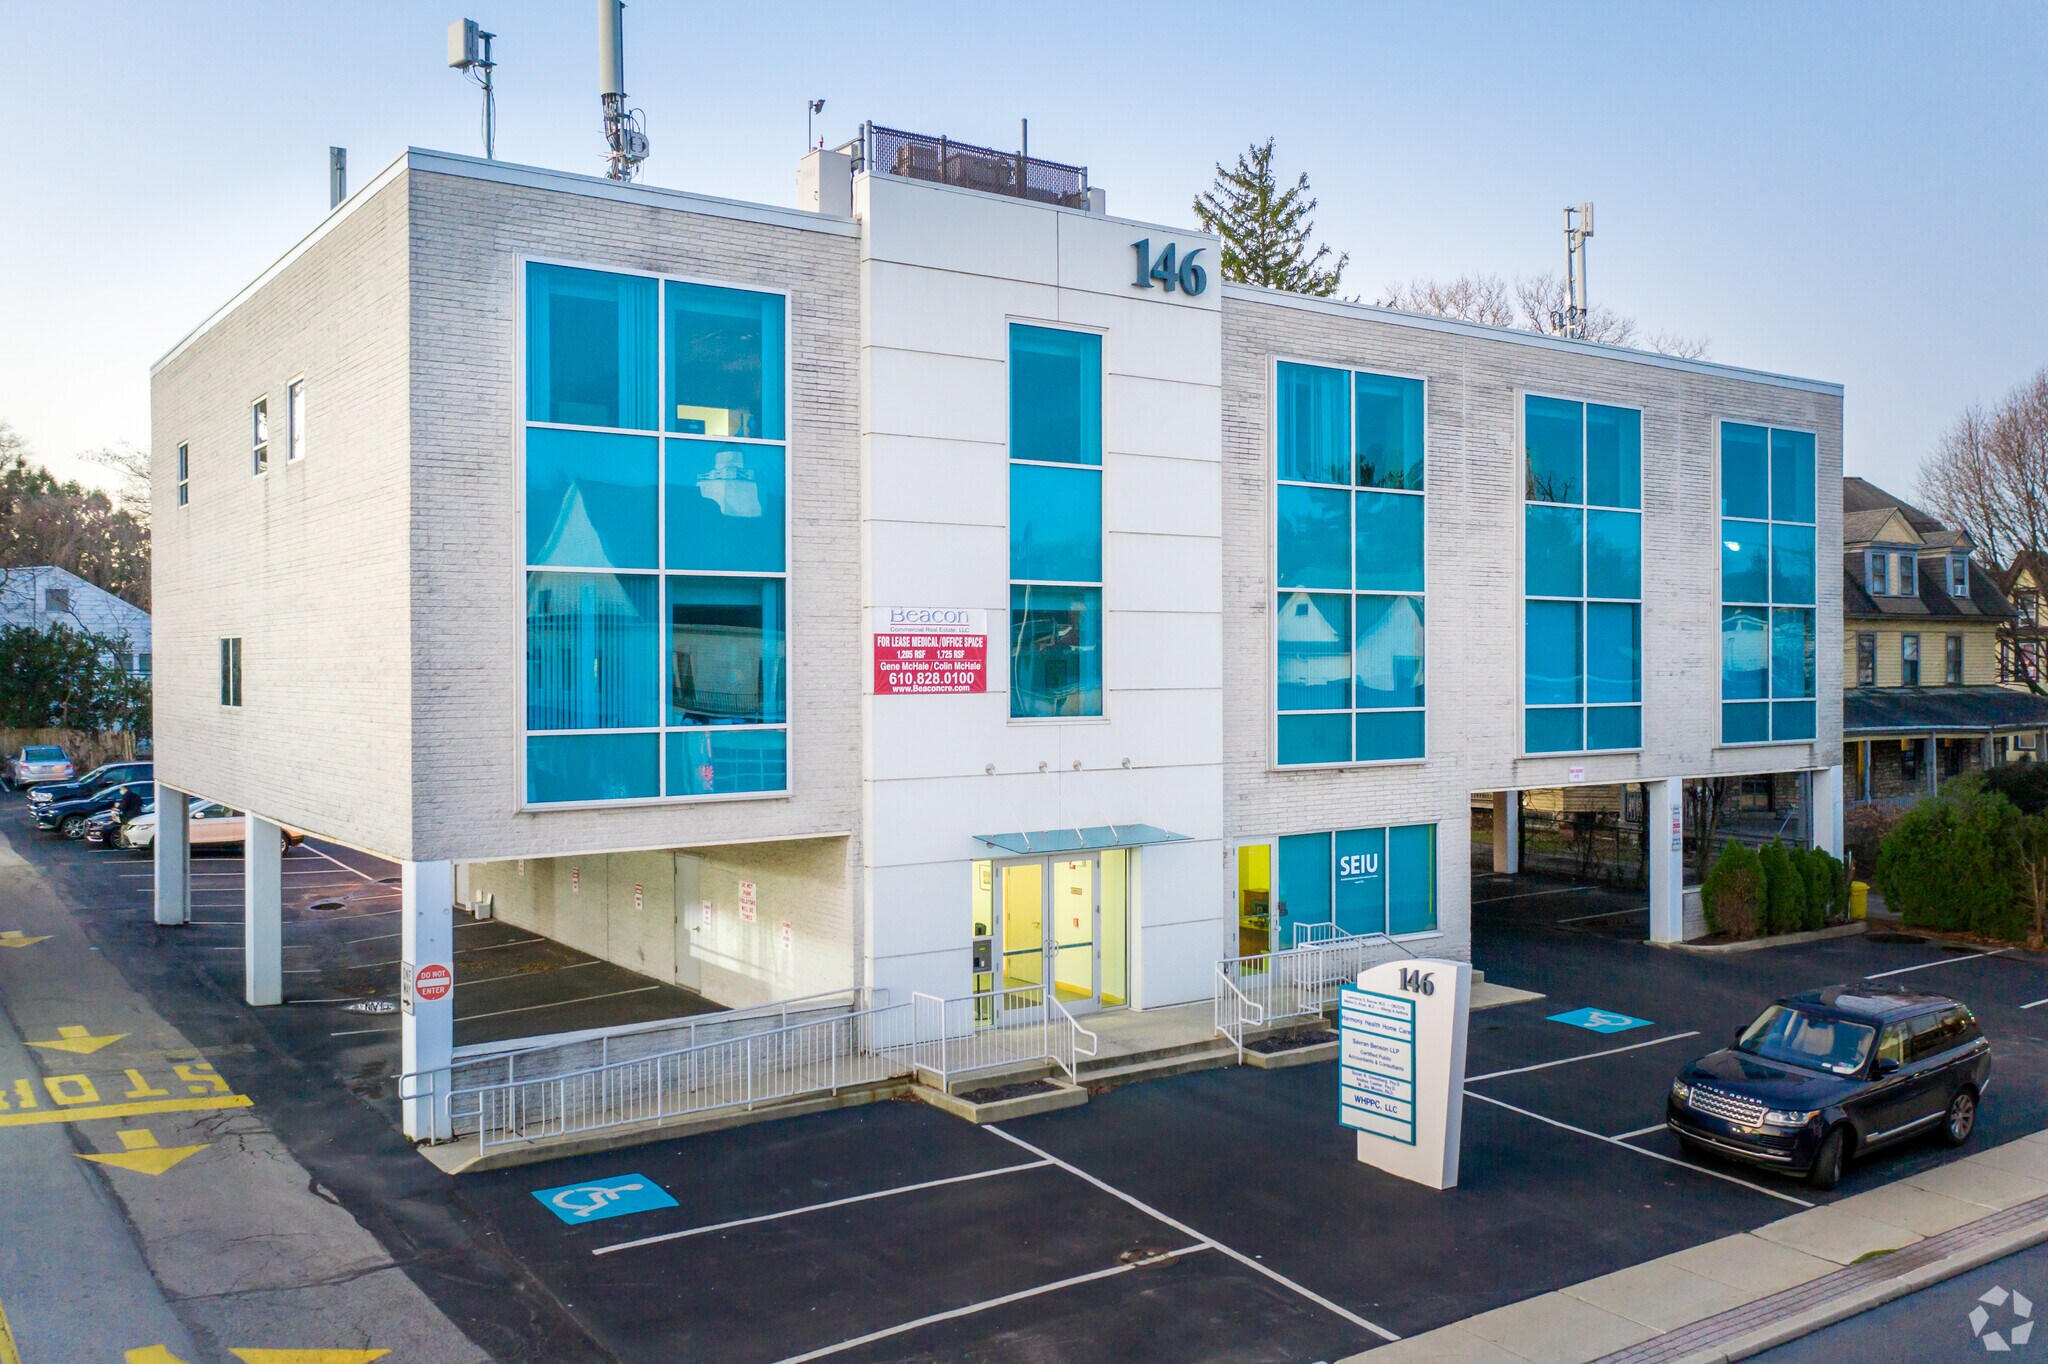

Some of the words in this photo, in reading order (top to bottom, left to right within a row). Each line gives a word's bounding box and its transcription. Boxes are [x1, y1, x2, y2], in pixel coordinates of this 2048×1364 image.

[1130, 238, 1207, 296] 146
[890, 608, 969, 623] Beacon
[877, 636, 890, 647] FOR
[891, 636, 911, 648] LEASE
[964, 637, 983, 648] SPACE
[896, 650, 913, 659] 1,205
[914, 650, 926, 659] RSF
[936, 650, 953, 659] 1,725
[953, 650, 965, 659] RSF
[880, 662, 900, 671] Gene
[901, 662, 929, 671] McHale
[933, 662, 953, 671] Colin
[954, 662, 981, 671] McHale
[889, 672, 975, 685] 610.828.0100
[892, 684, 970, 693] www.Beaconcre.com
[1340, 853, 1378, 876] SEIU
[421, 971, 431, 979] DO
[432, 970, 446, 978] NOT
[1398, 967, 1435, 996] 146
[422, 986, 445, 995] ENTER
[1382, 1023, 1397, 1032] Home
[1697, 1082, 1725, 1095] RANGE
[1729, 1093, 1763, 1105] ROVER
[1385, 1104, 1398, 1114] LLC
